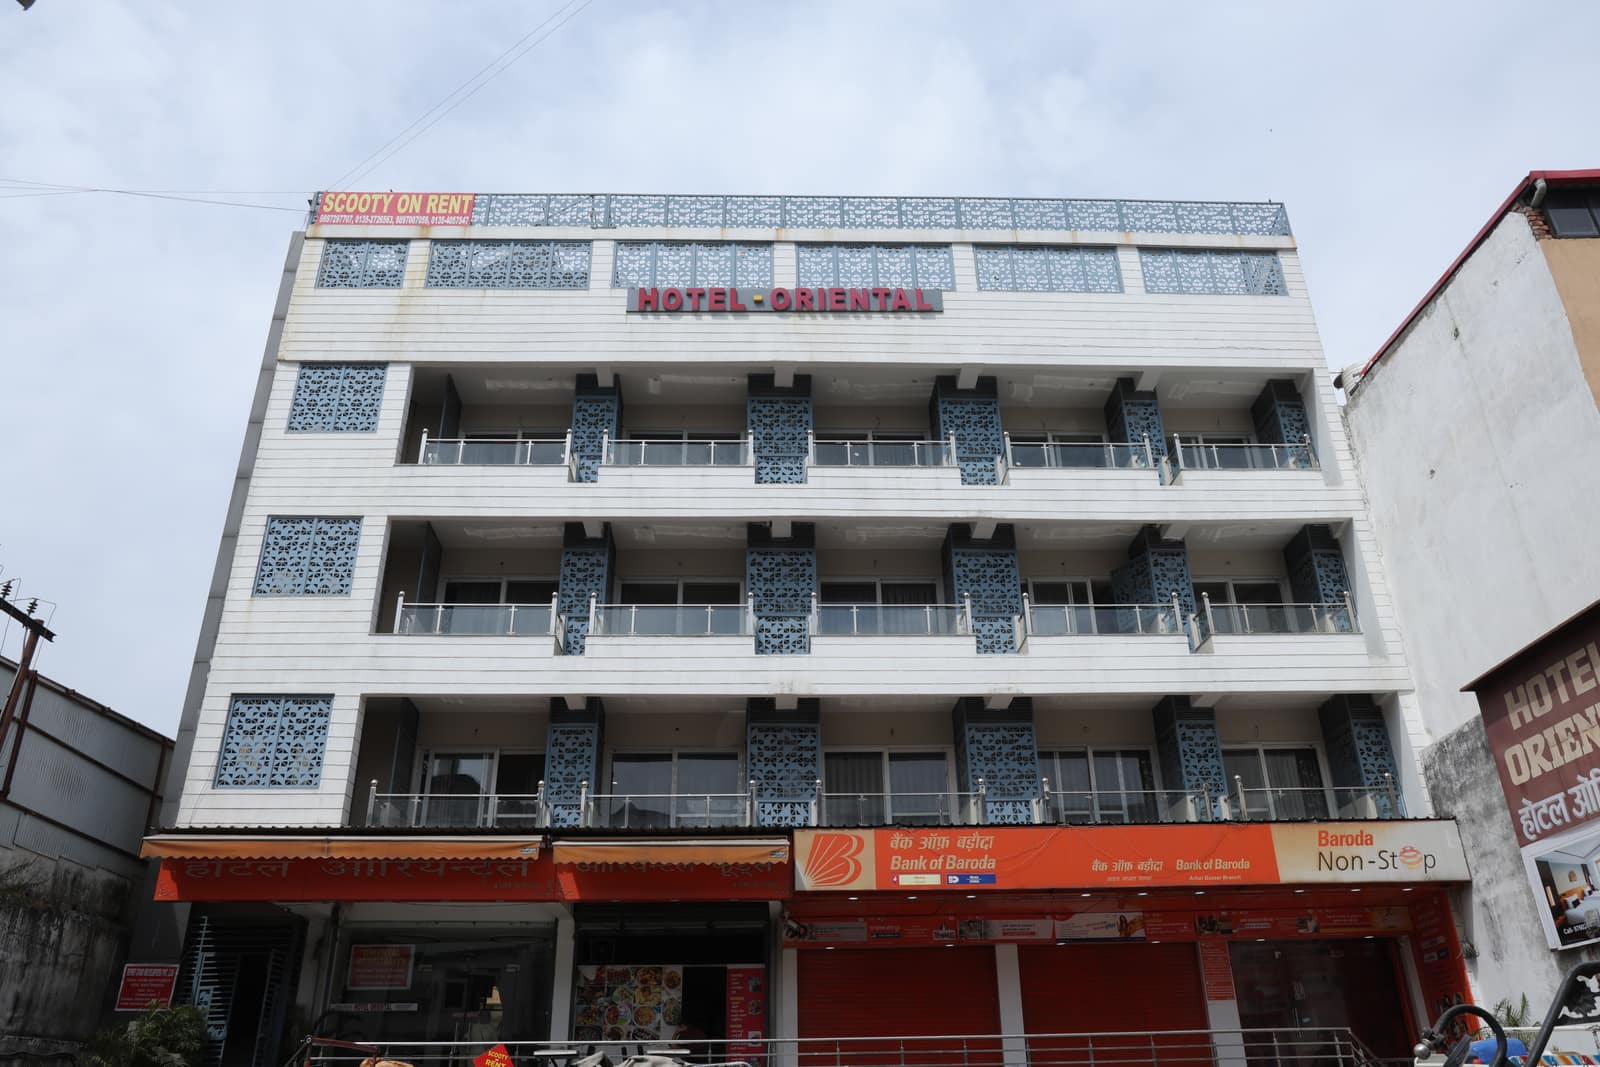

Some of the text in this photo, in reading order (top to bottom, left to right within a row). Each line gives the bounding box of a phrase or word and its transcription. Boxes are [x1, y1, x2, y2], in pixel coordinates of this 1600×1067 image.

[322, 193, 474, 214] SCOOTY ON RENT
[638, 287, 933, 311] HOTEL ORIENTAL
[1504, 703, 1600, 786] ORIEN
[1518, 792, 1571, 842] होटल
[889, 832, 914, 849] बैंक
[956, 831, 996, 852] बड़ौदा
[1318, 830, 1374, 847] Baroda
[890, 854, 997, 870] Bank of Baroda
[1176, 858, 1250, 870] Bank of Baroda
[488, 1050, 509, 1060] SCOOTY
